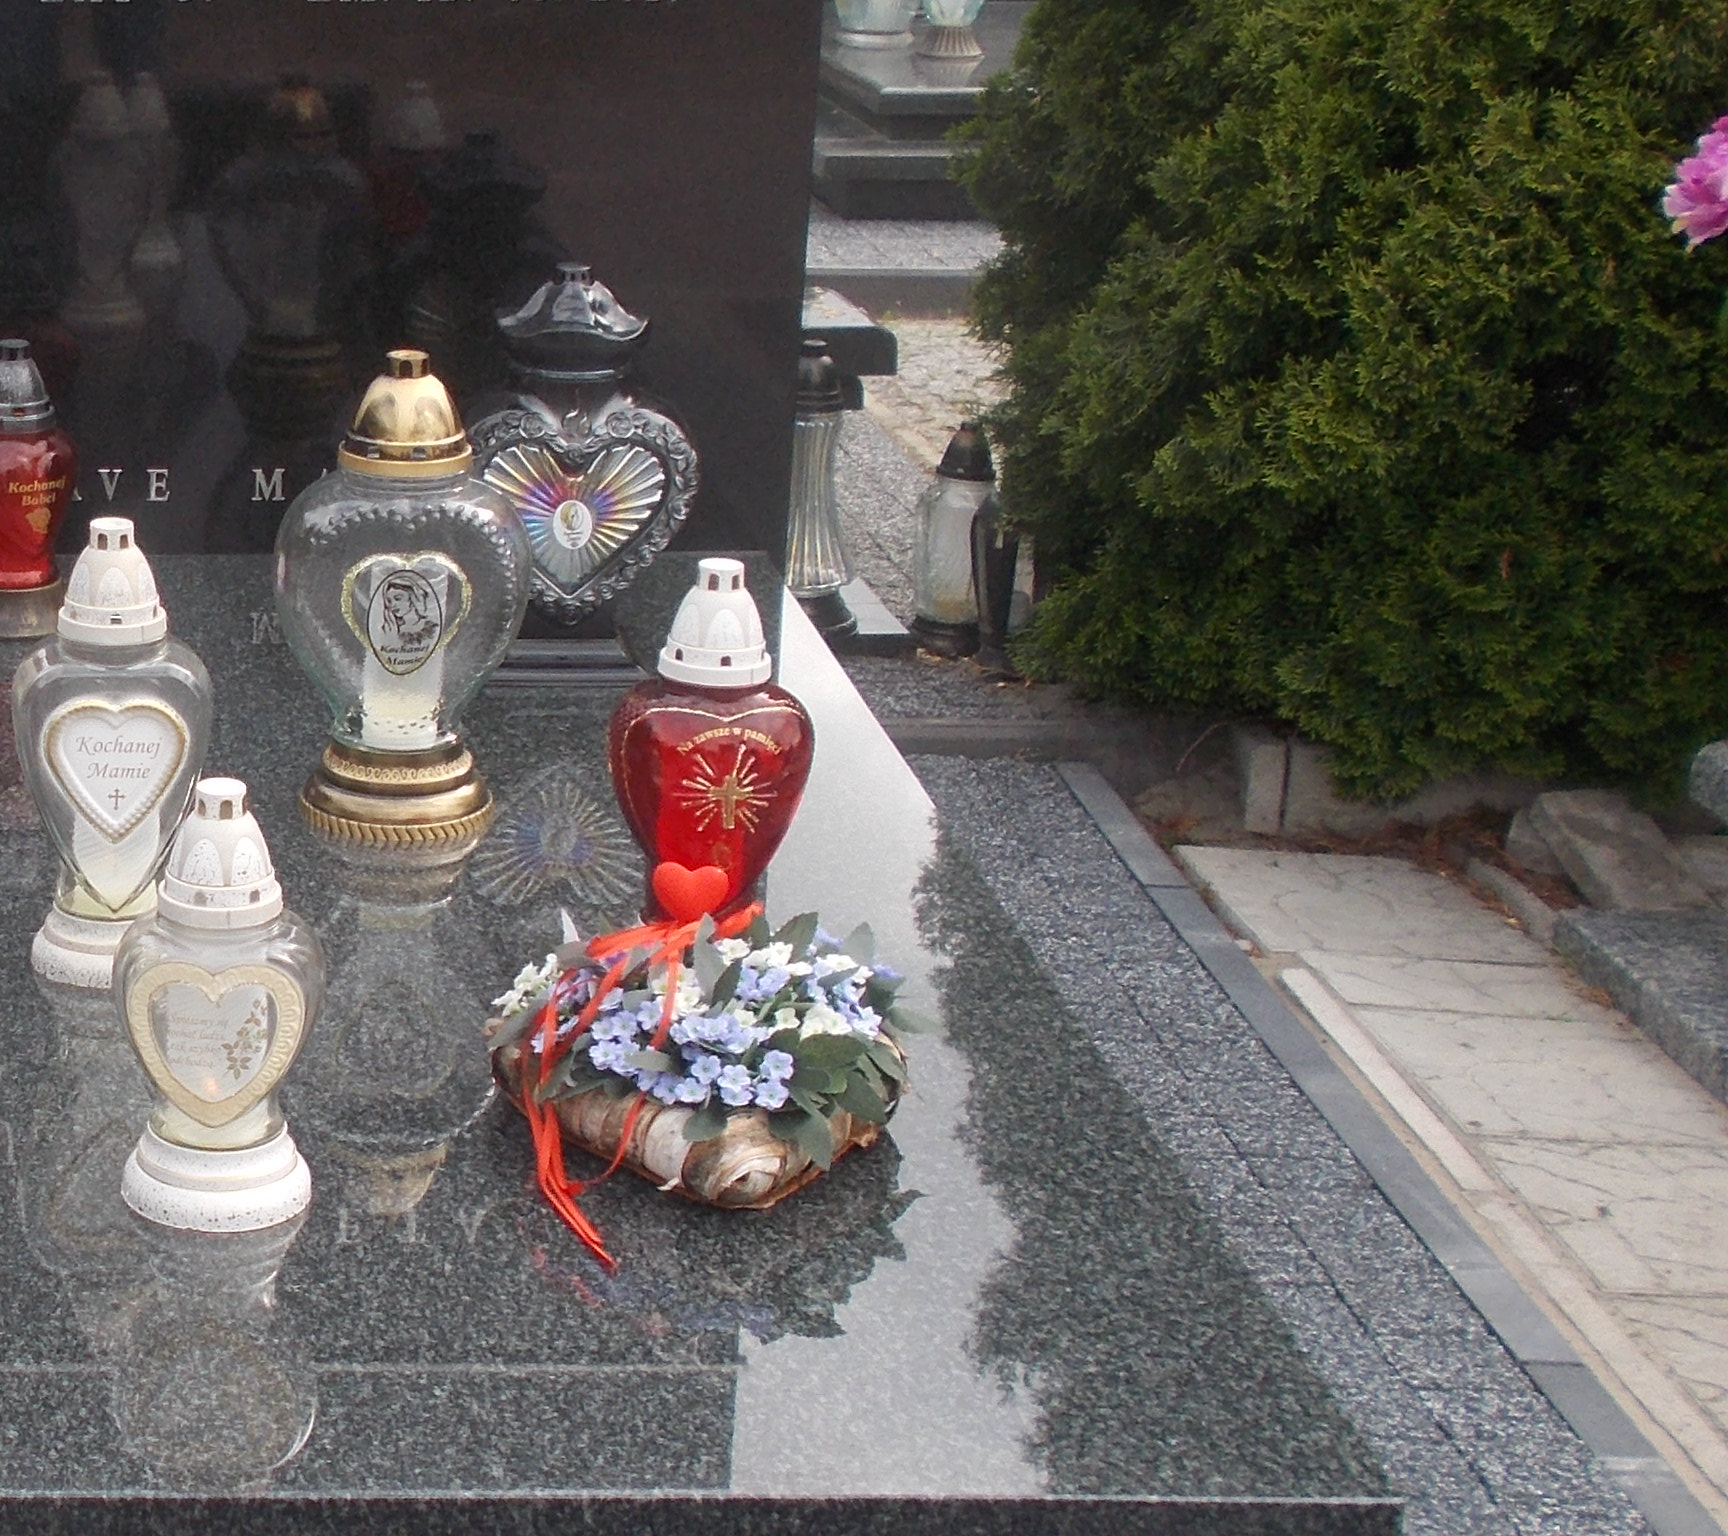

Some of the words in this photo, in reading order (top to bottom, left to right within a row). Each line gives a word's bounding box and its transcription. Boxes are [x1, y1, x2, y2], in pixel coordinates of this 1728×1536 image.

[693, 727, 730, 745] zawsze
[74, 734, 162, 760] Kochanej
[86, 762, 152, 780] Mamie
